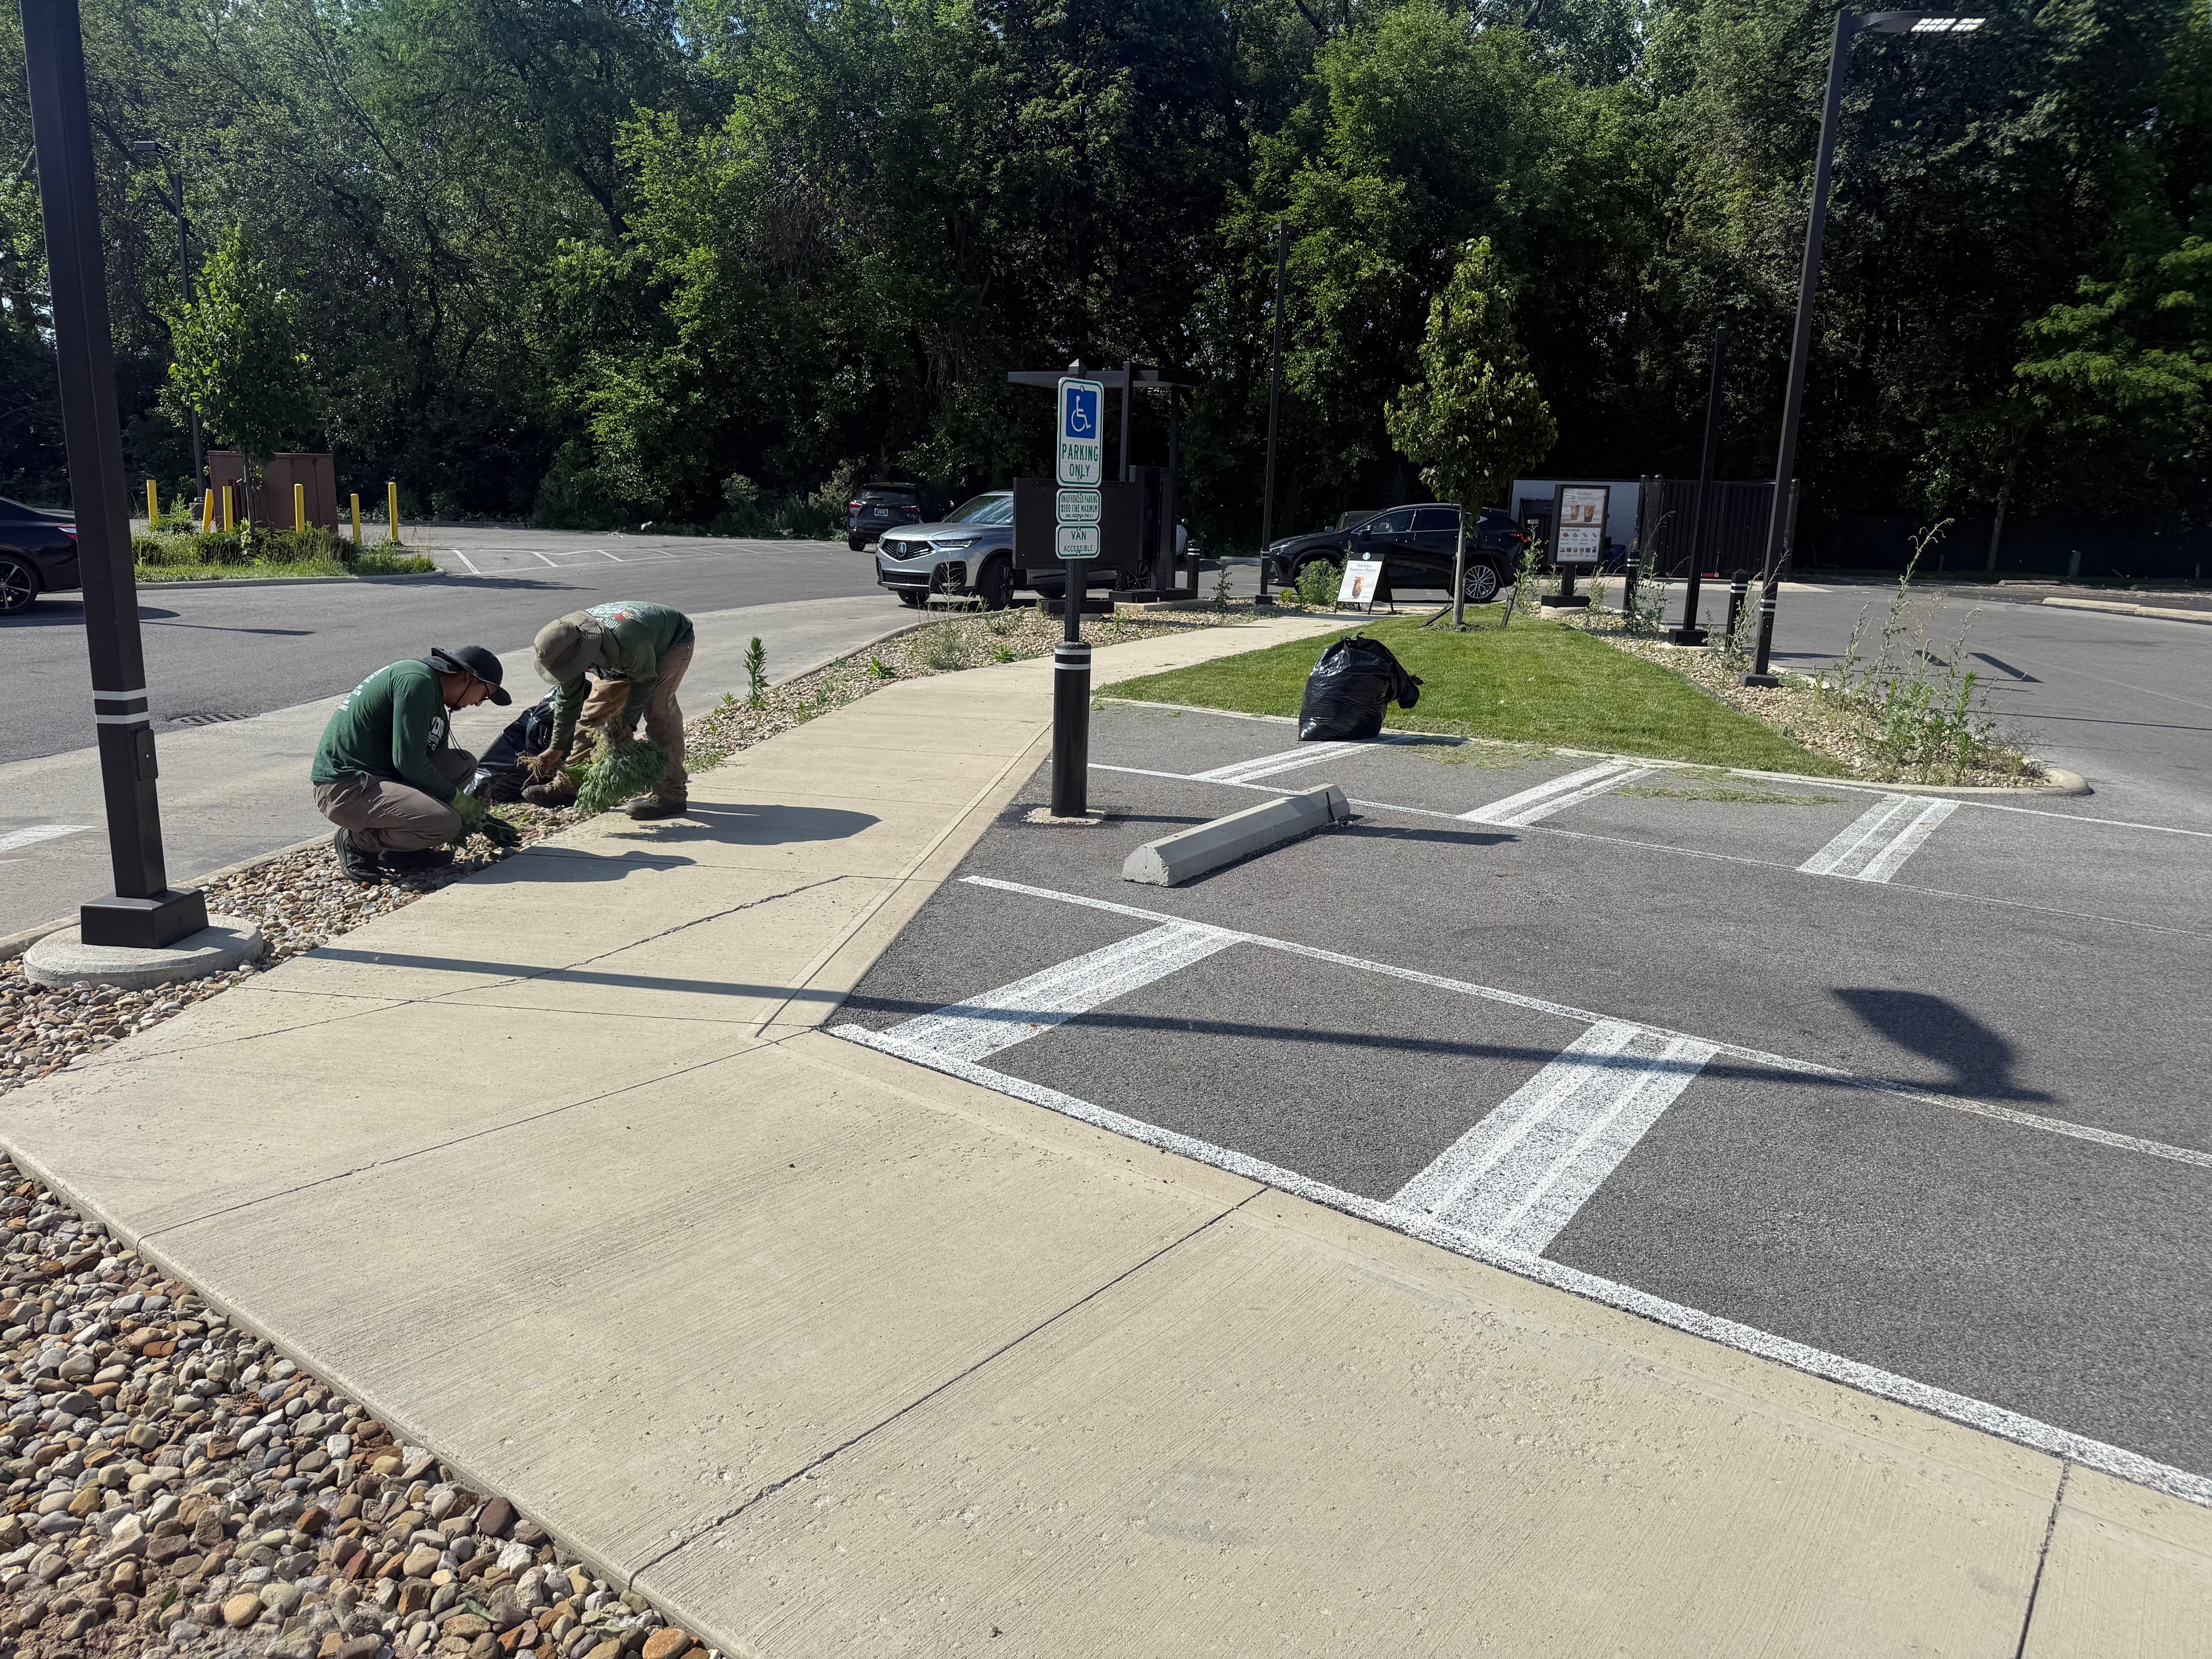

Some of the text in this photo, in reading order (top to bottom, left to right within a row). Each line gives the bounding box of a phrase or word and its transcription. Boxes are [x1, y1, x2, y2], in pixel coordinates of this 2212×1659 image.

[1062, 444, 1098, 461] PARKING
[1070, 463, 1090, 477] ONLY
[1084, 494, 1098, 503] PARKING
[1060, 504, 1098, 512] $500 FINE MAXIMUM
[1071, 531, 1086, 540] VAN
